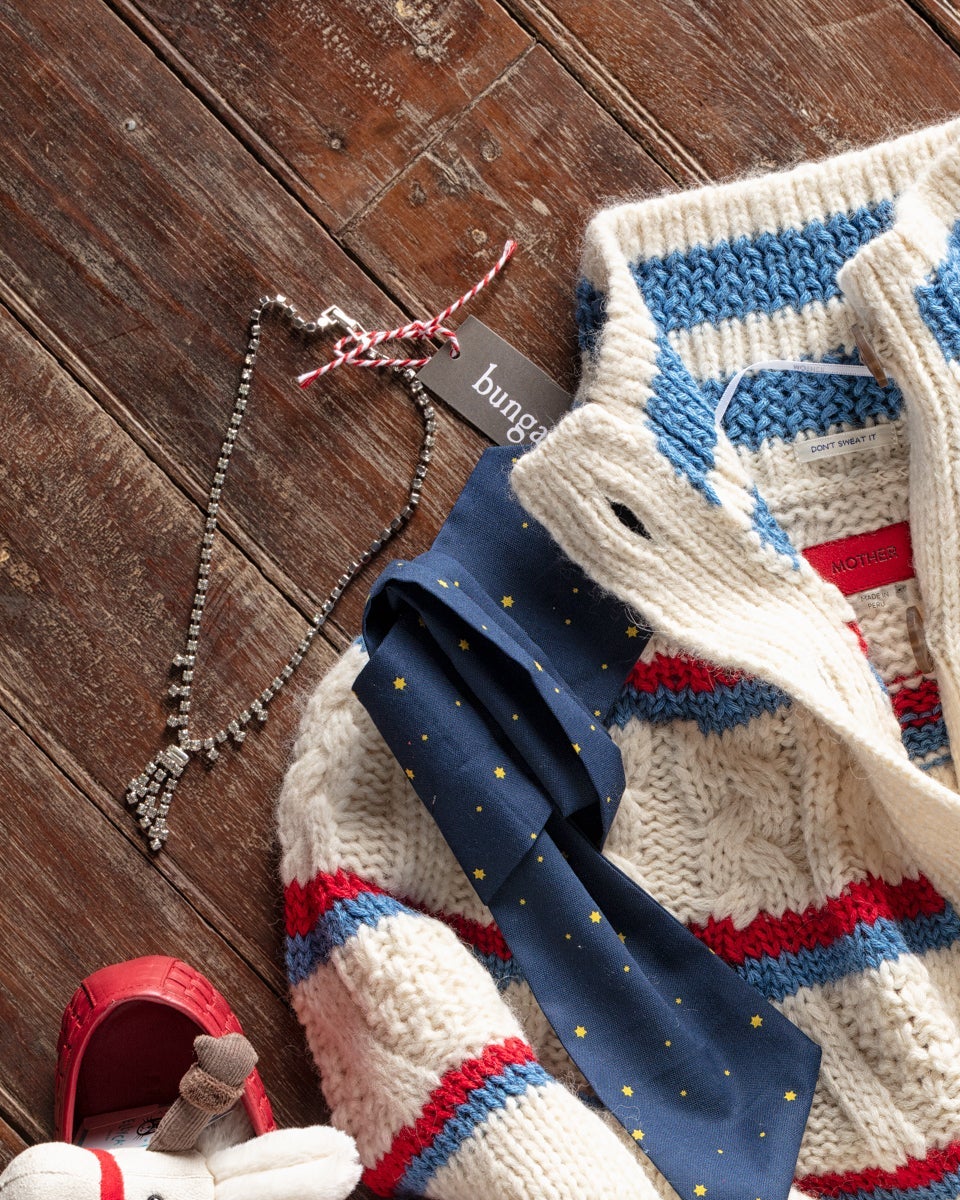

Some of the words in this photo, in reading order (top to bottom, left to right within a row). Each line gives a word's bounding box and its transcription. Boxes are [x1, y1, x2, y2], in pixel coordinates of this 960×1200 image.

[838, 436, 866, 448] SWEAT
[868, 433, 878, 442] IT
[831, 544, 899, 575] MOTHER
[860, 592, 880, 603] MADE
[881, 591, 890, 600] IN
[867, 600, 886, 609] PERU
